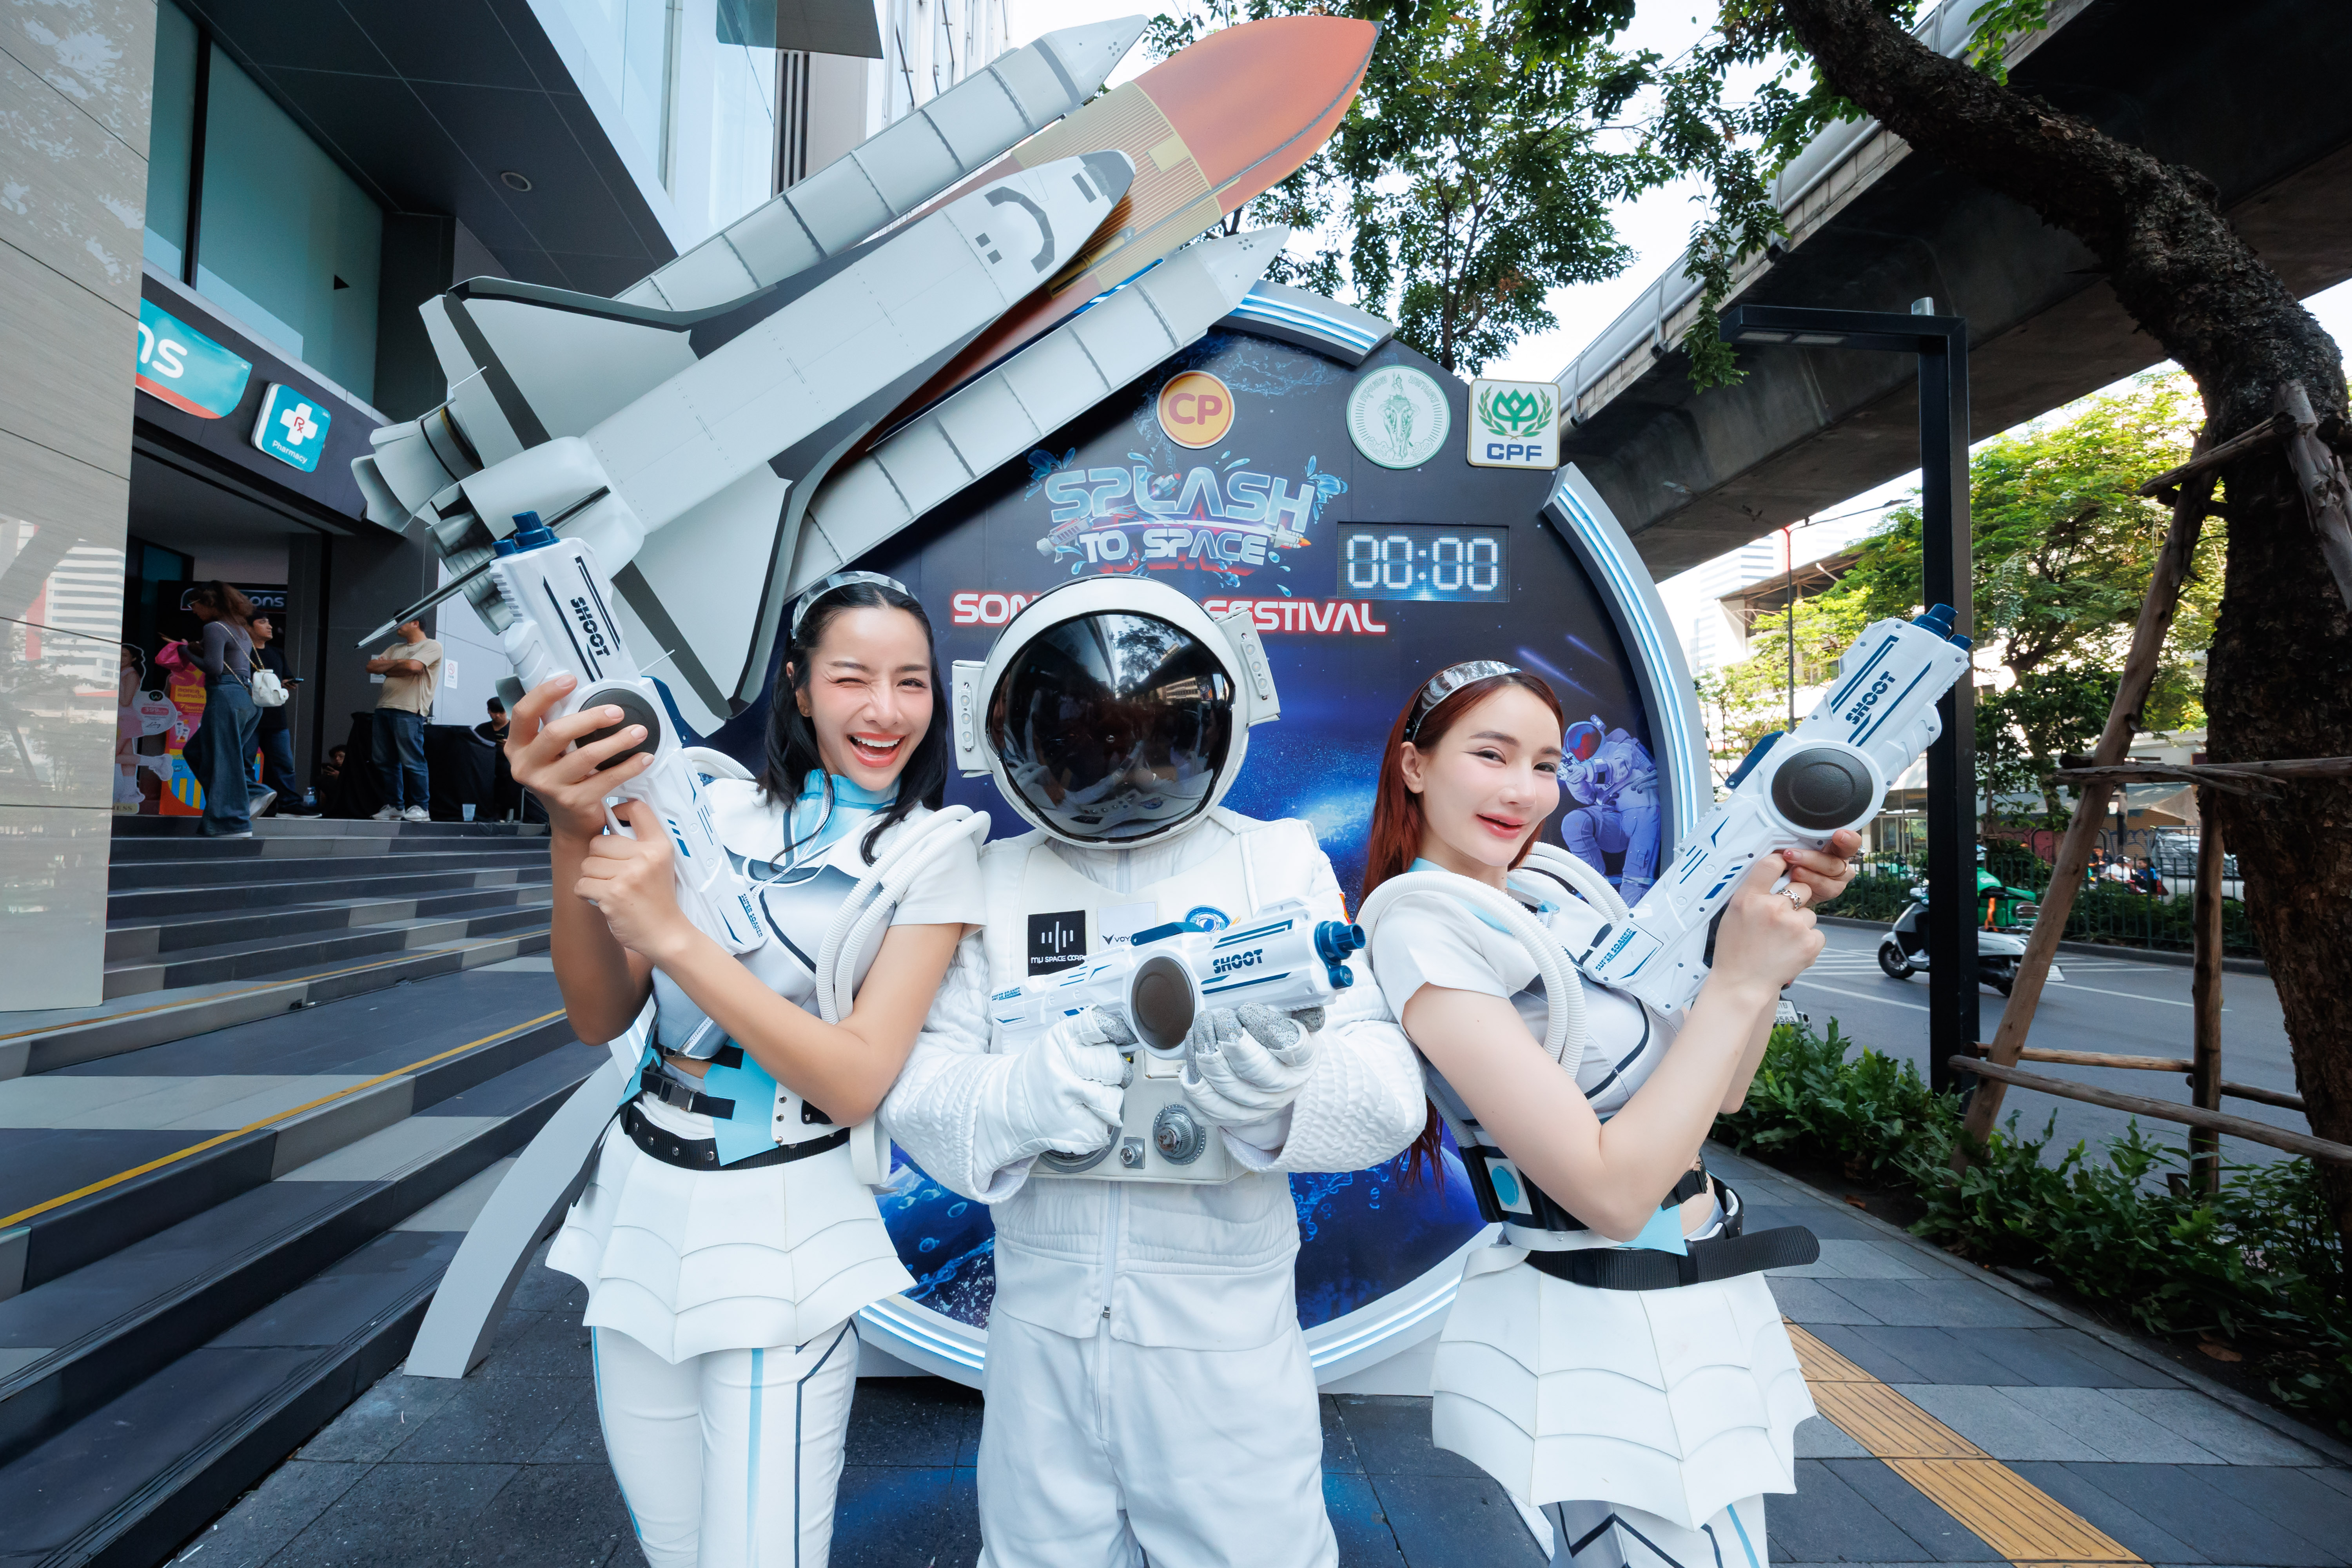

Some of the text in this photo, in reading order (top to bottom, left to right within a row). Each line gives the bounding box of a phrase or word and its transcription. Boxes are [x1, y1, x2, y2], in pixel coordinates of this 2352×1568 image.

[1168, 392, 1223, 425] CP
[272, 440, 308, 464] Pharmacy
[1487, 443, 1542, 461] CPF
[1044, 465, 1316, 533] SPLASH
[1079, 529, 1267, 565] TO SPACE
[1347, 535, 1498, 591] 00:00
[570, 597, 611, 656] SHOOT
[1845, 671, 1896, 725] SHOOT
[741, 893, 763, 938] SUPER SOAKER
[1212, 949, 1263, 974] SHOOT
[1595, 928, 1633, 971] SUPER SOAKER
